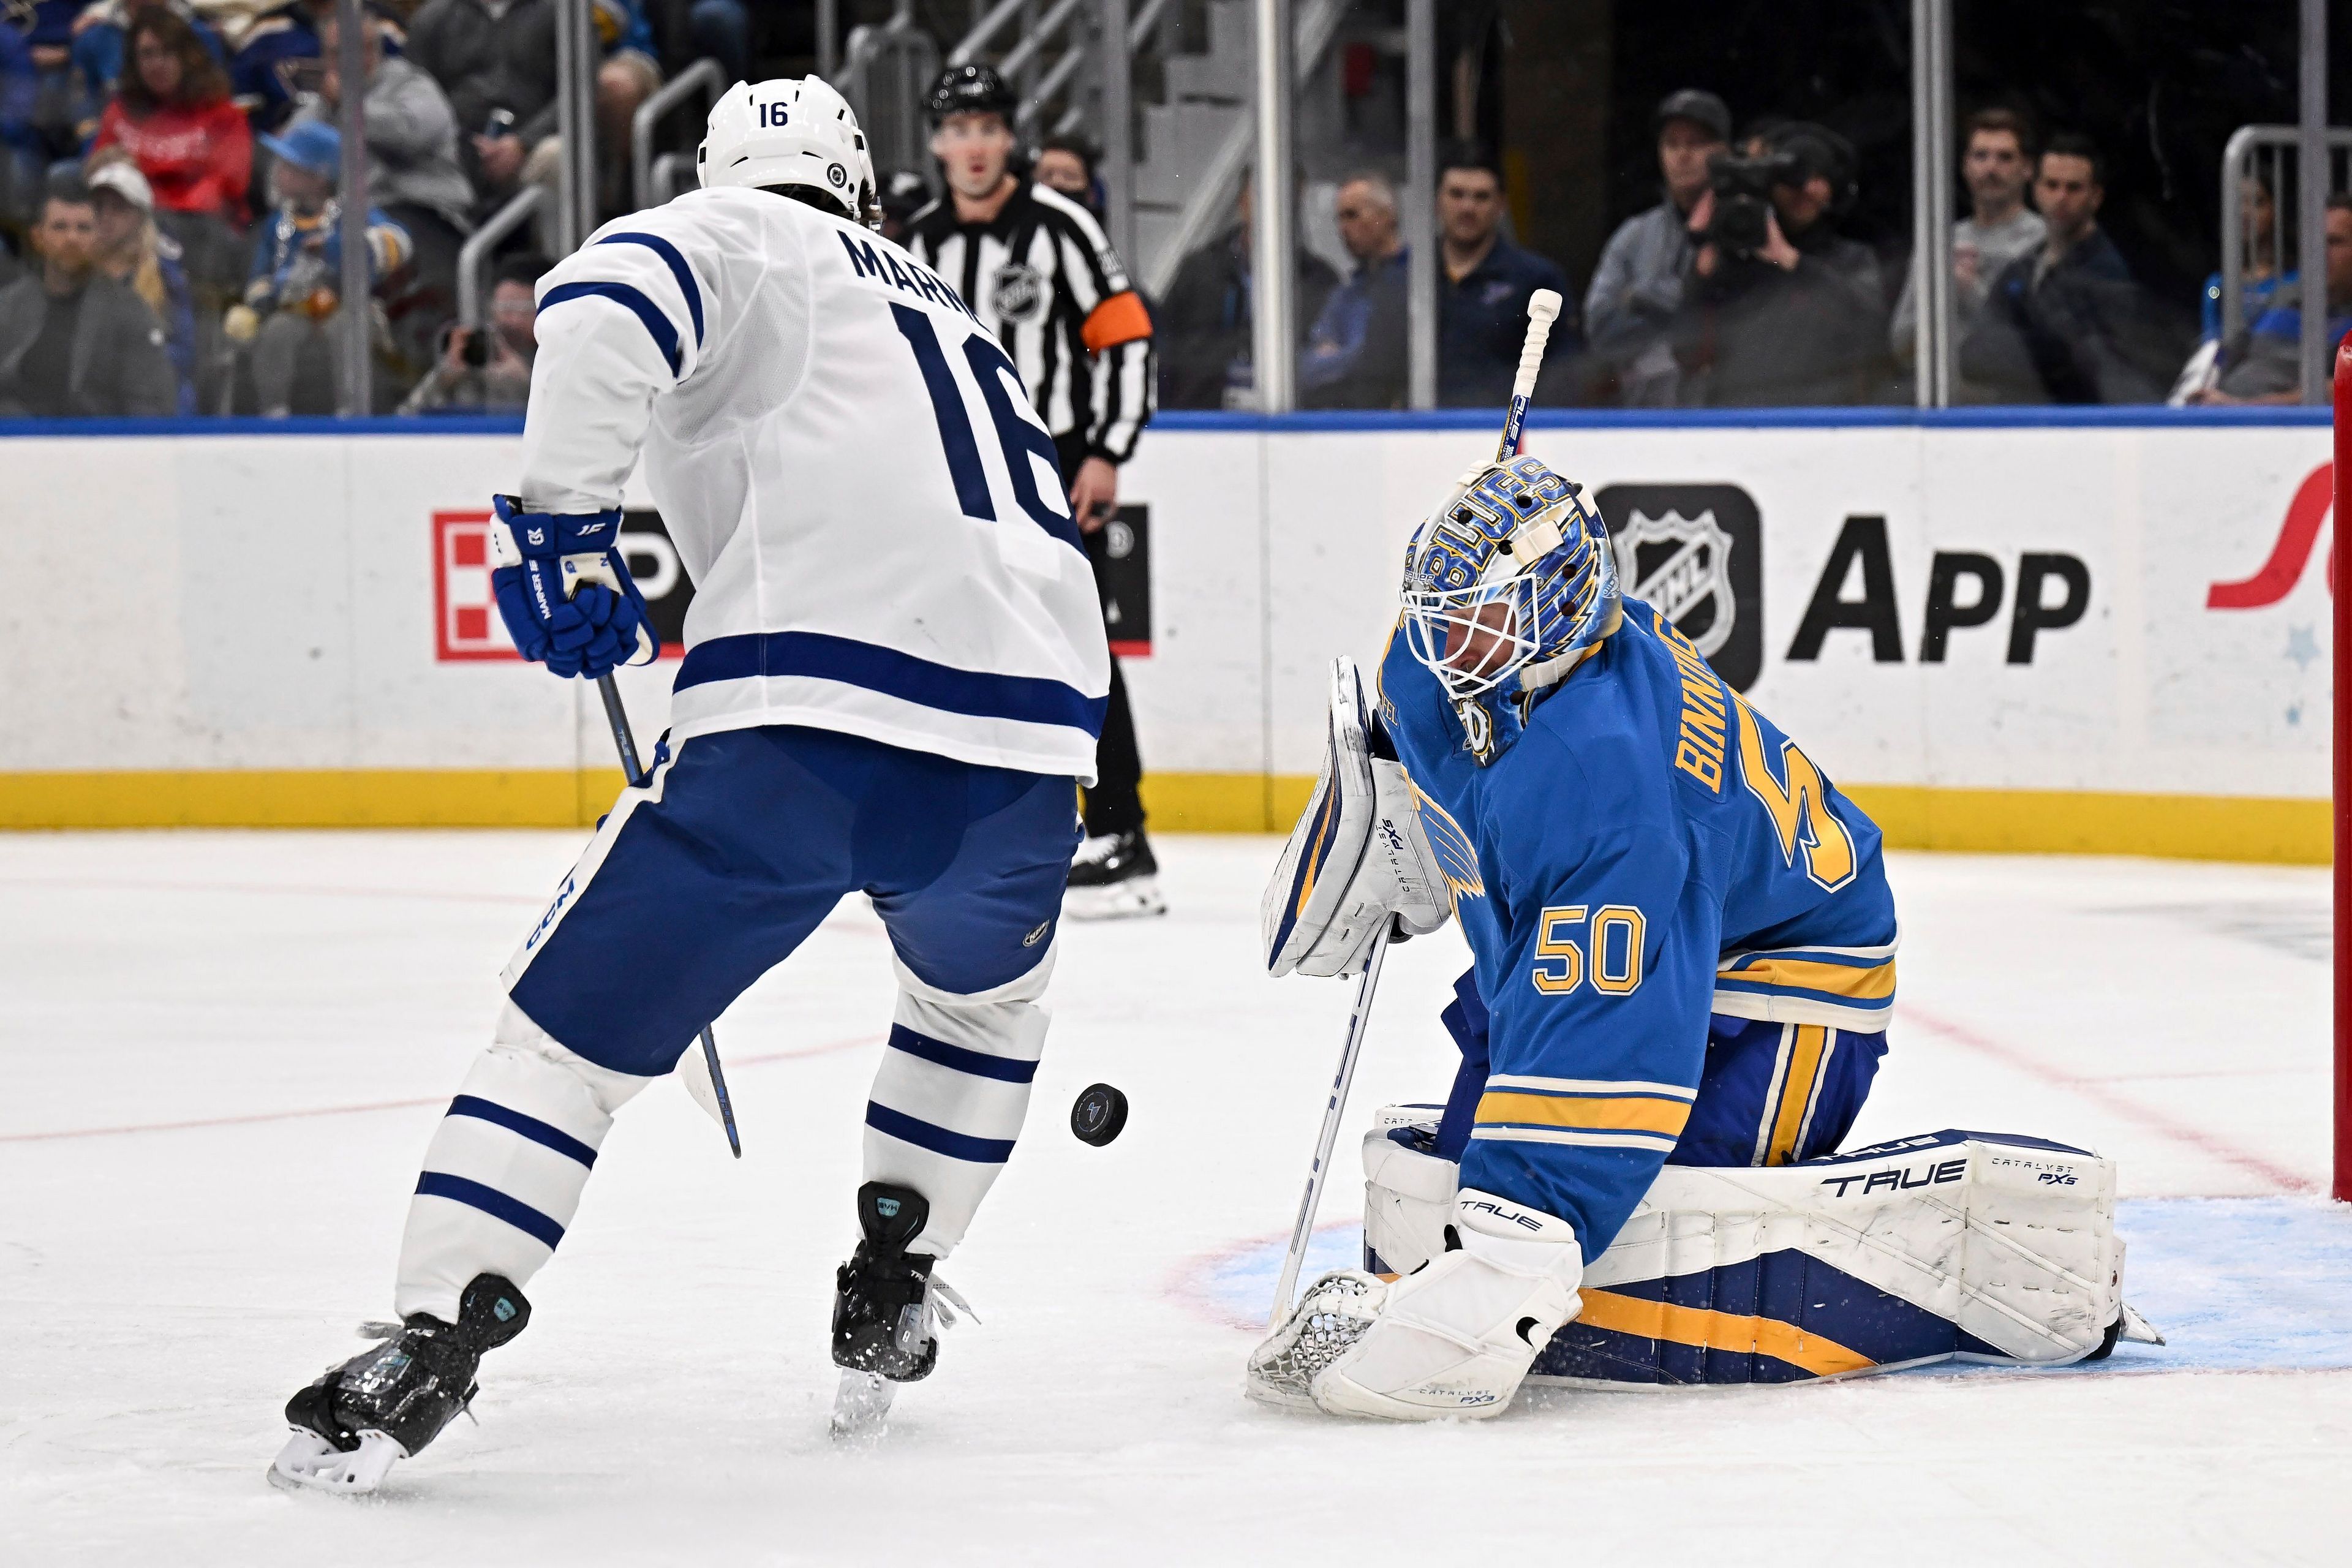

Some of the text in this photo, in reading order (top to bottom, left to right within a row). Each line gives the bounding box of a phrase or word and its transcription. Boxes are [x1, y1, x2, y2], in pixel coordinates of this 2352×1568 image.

[760, 102, 788, 128] 16
[837, 230, 995, 338] MARN
[888, 301, 1090, 561] 16
[1417, 457, 1572, 605] BLUES
[1375, 824, 1410, 892] CATALYST
[526, 877, 575, 950] CCM
[1532, 904, 1647, 997] 50
[1808, 1135, 1940, 1161] TRUE
[1992, 1158, 2074, 1174] CATALYST
[1820, 1158, 1968, 1198] TRUE
[1460, 1201, 1544, 1232] TRUE
[911, 1270, 928, 1283] TRU
